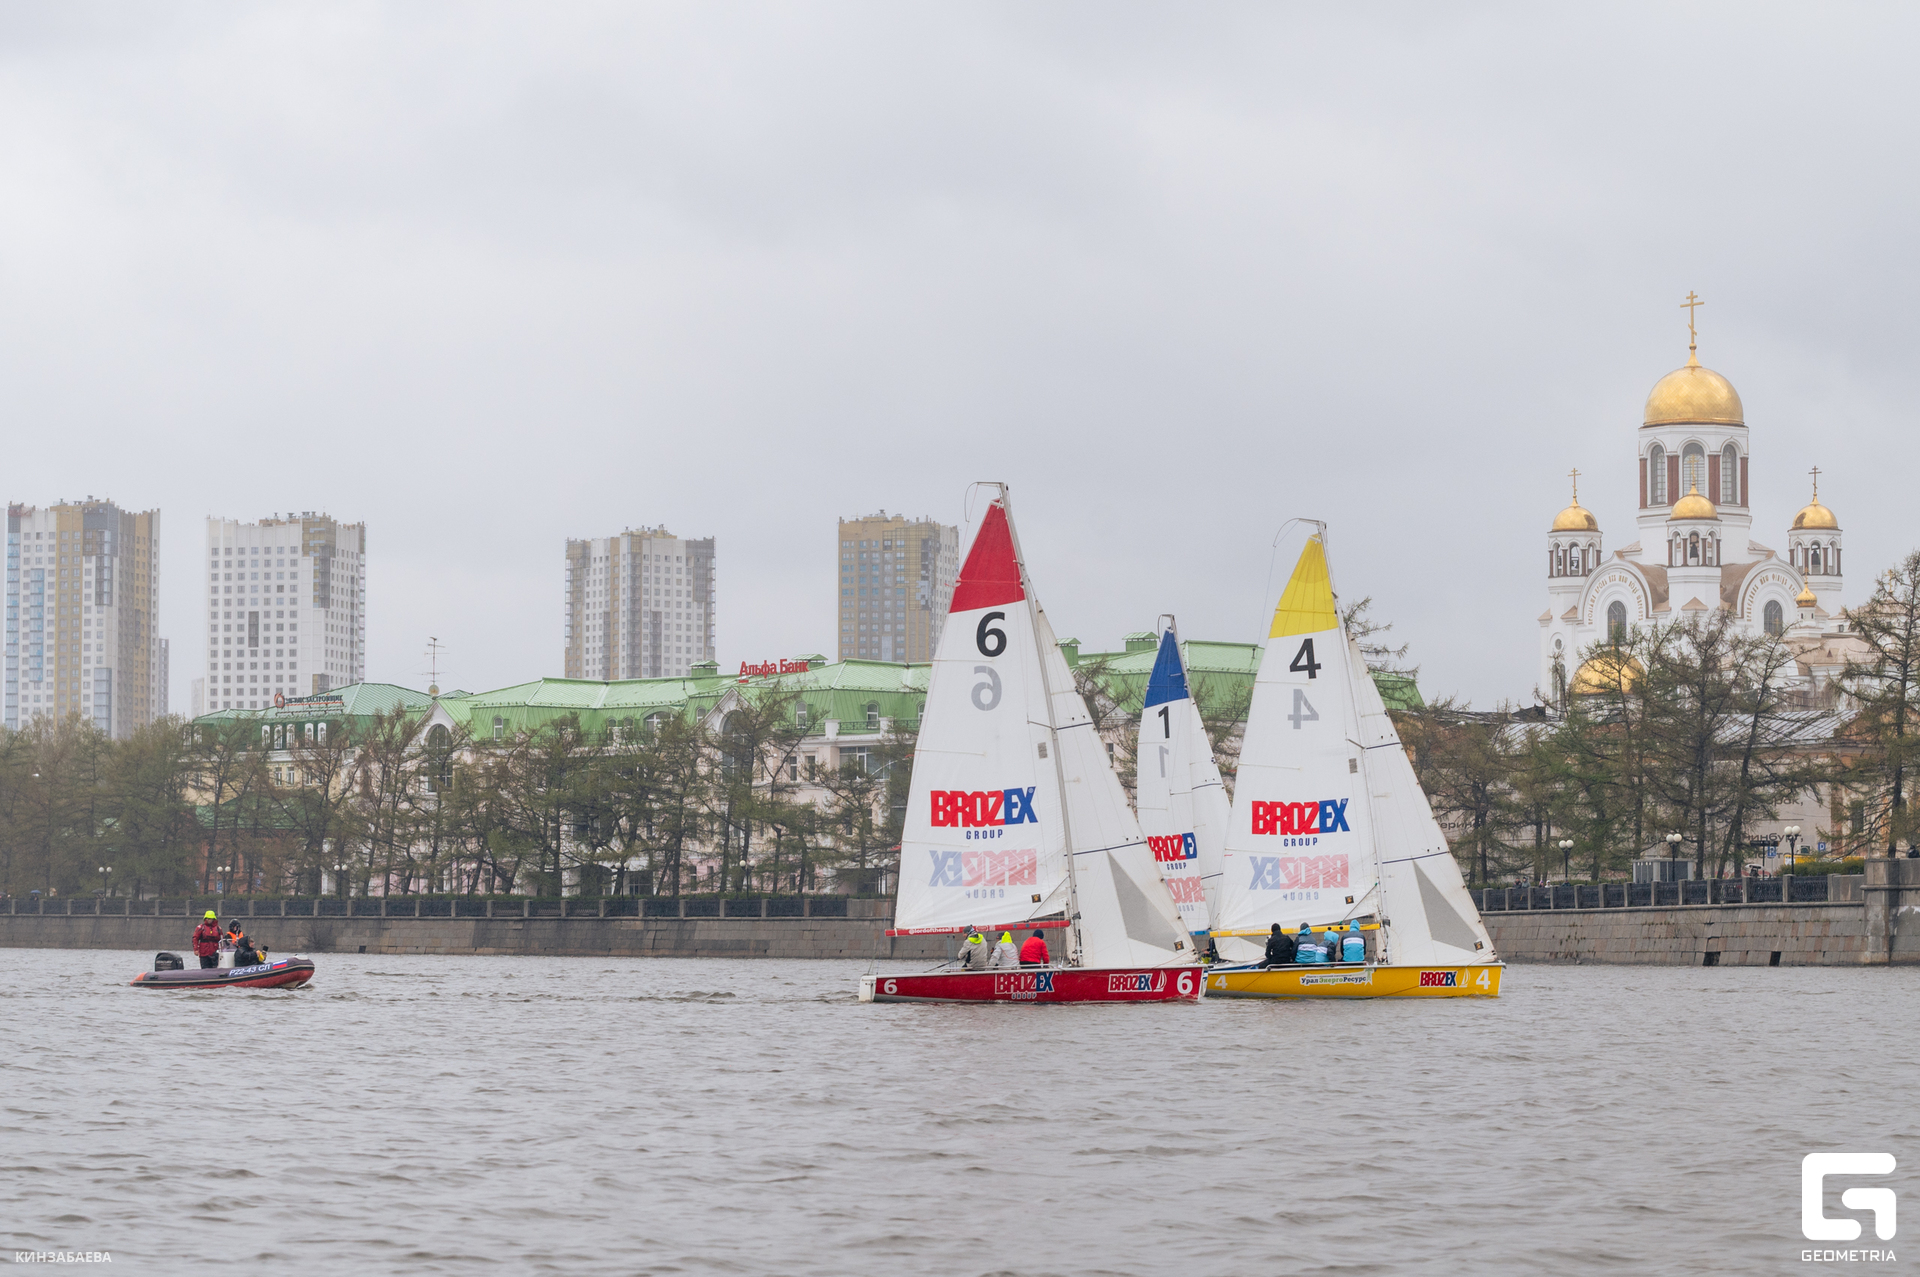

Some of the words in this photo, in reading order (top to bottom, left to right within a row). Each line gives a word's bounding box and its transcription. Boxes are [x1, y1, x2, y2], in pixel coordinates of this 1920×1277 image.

[976, 611, 1007, 657] 6
[739, 660, 777, 679] Альфа
[780, 659, 809, 674] Банк
[1289, 638, 1321, 679] 4
[1158, 705, 1170, 739] 1
[930, 786, 1039, 828] BROZEX
[1251, 798, 1351, 835] BROZEX
[966, 829, 1003, 840] GROUP
[1283, 837, 1318, 847] GROUP
[1167, 862, 1187, 870] GROUP
[883, 978, 898, 994] 6
[995, 972, 1055, 994] BROZEX
[1108, 974, 1152, 992] BROZEX
[1176, 971, 1193, 994] 6
[1215, 975, 1228, 989] 4
[1419, 971, 1458, 987] BROZEX
[1475, 968, 1491, 990] 4
